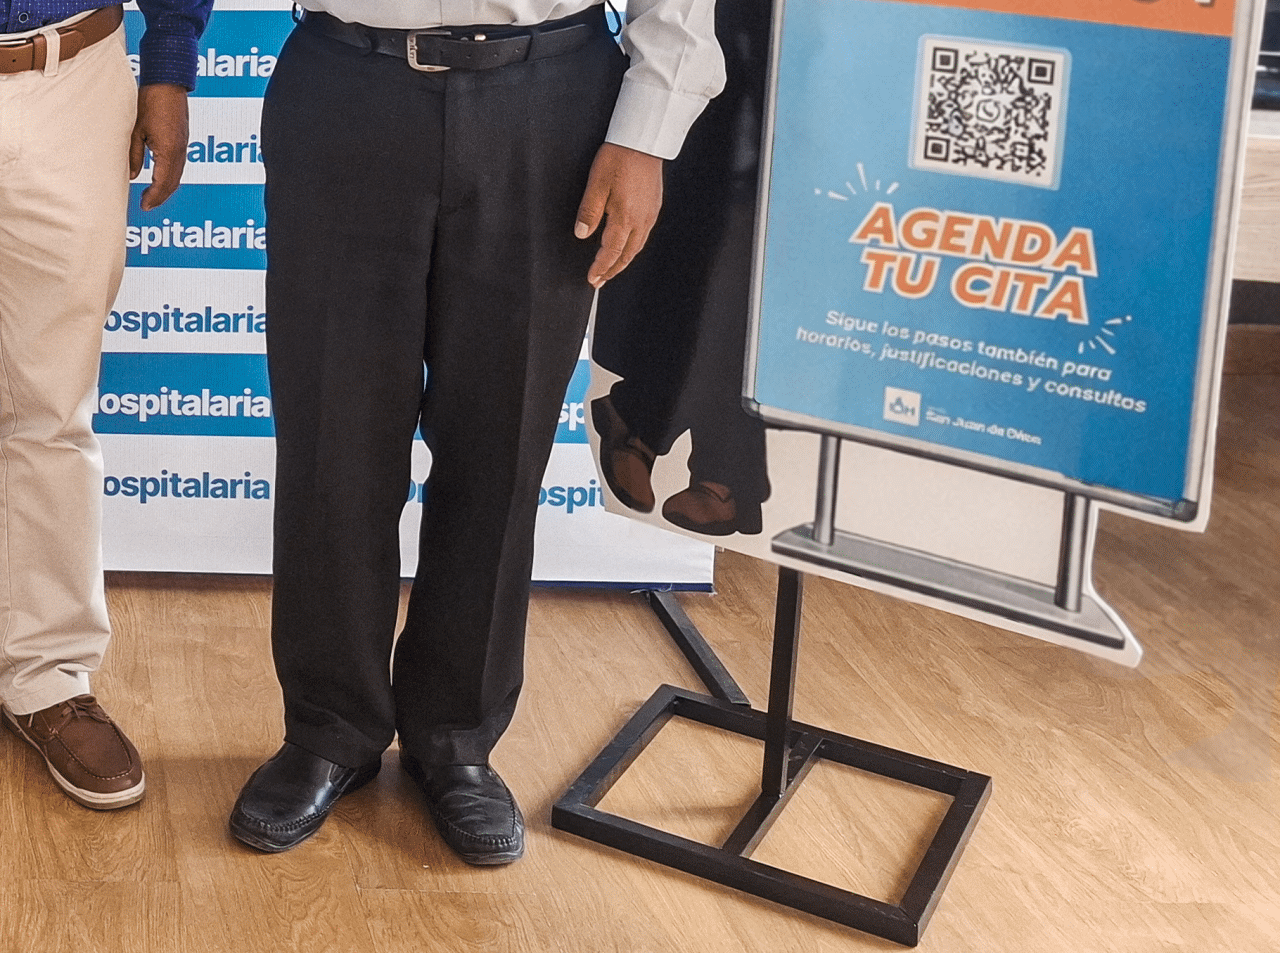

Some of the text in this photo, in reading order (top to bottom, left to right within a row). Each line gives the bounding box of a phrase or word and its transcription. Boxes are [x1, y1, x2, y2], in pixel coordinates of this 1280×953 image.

[125, 219, 267, 254] spitalaria
[849, 202, 1098, 277] AGENDA
[104, 304, 266, 339] ospitalaria
[860, 247, 1089, 325] TU CITA
[796, 326, 1147, 413] horarios, justificaciones y consultas
[825, 310, 1113, 381] Sigue los pasos también para
[104, 469, 270, 504] ospitalaria
